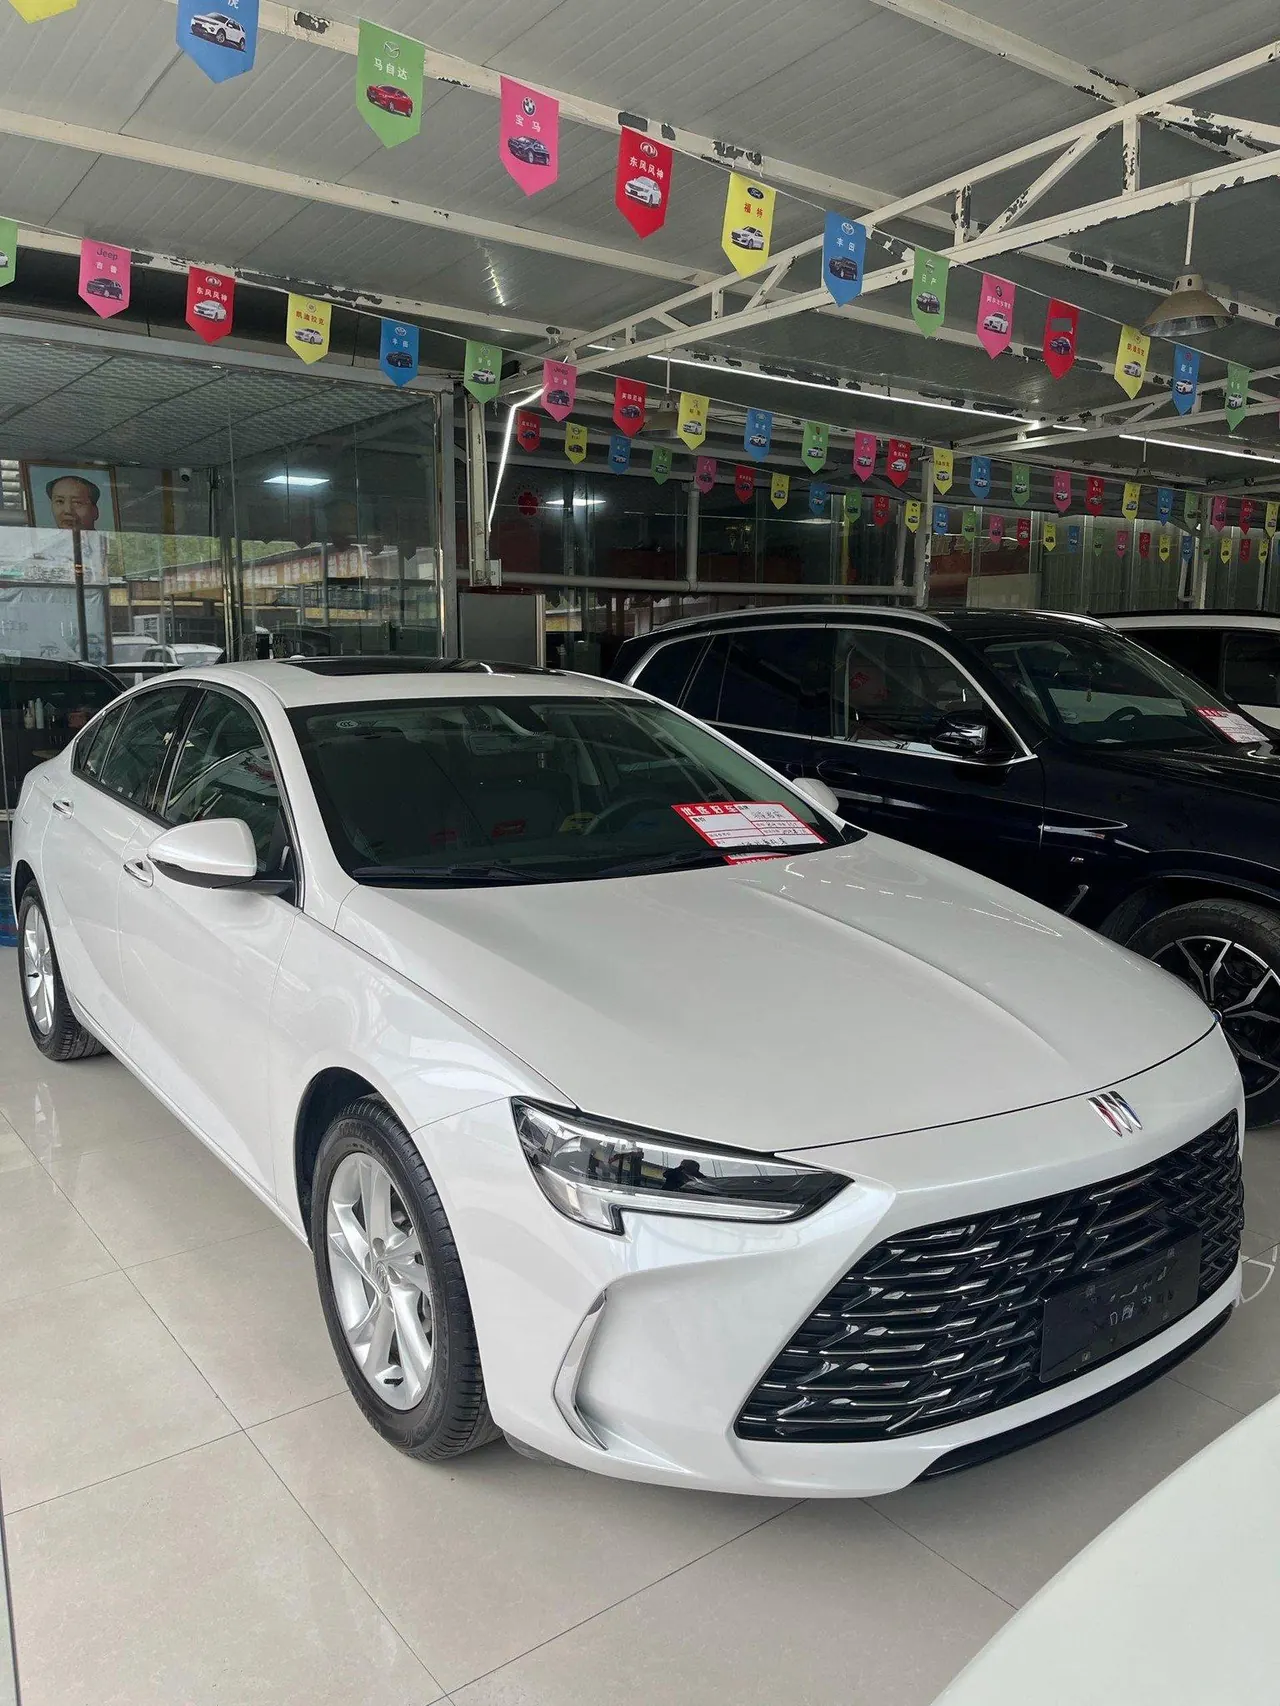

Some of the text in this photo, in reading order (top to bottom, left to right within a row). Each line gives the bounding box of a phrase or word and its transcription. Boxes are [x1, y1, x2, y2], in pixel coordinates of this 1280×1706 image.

[373, 57, 409, 80] 马自达
[515, 114, 542, 132] 宝马
[629, 156, 664, 180] 东风风神
[743, 202, 764, 218] 福特
[836, 237, 855, 252] 丰田
[96, 248, 119, 261] Jeep
[195, 287, 228, 302] 东风风神
